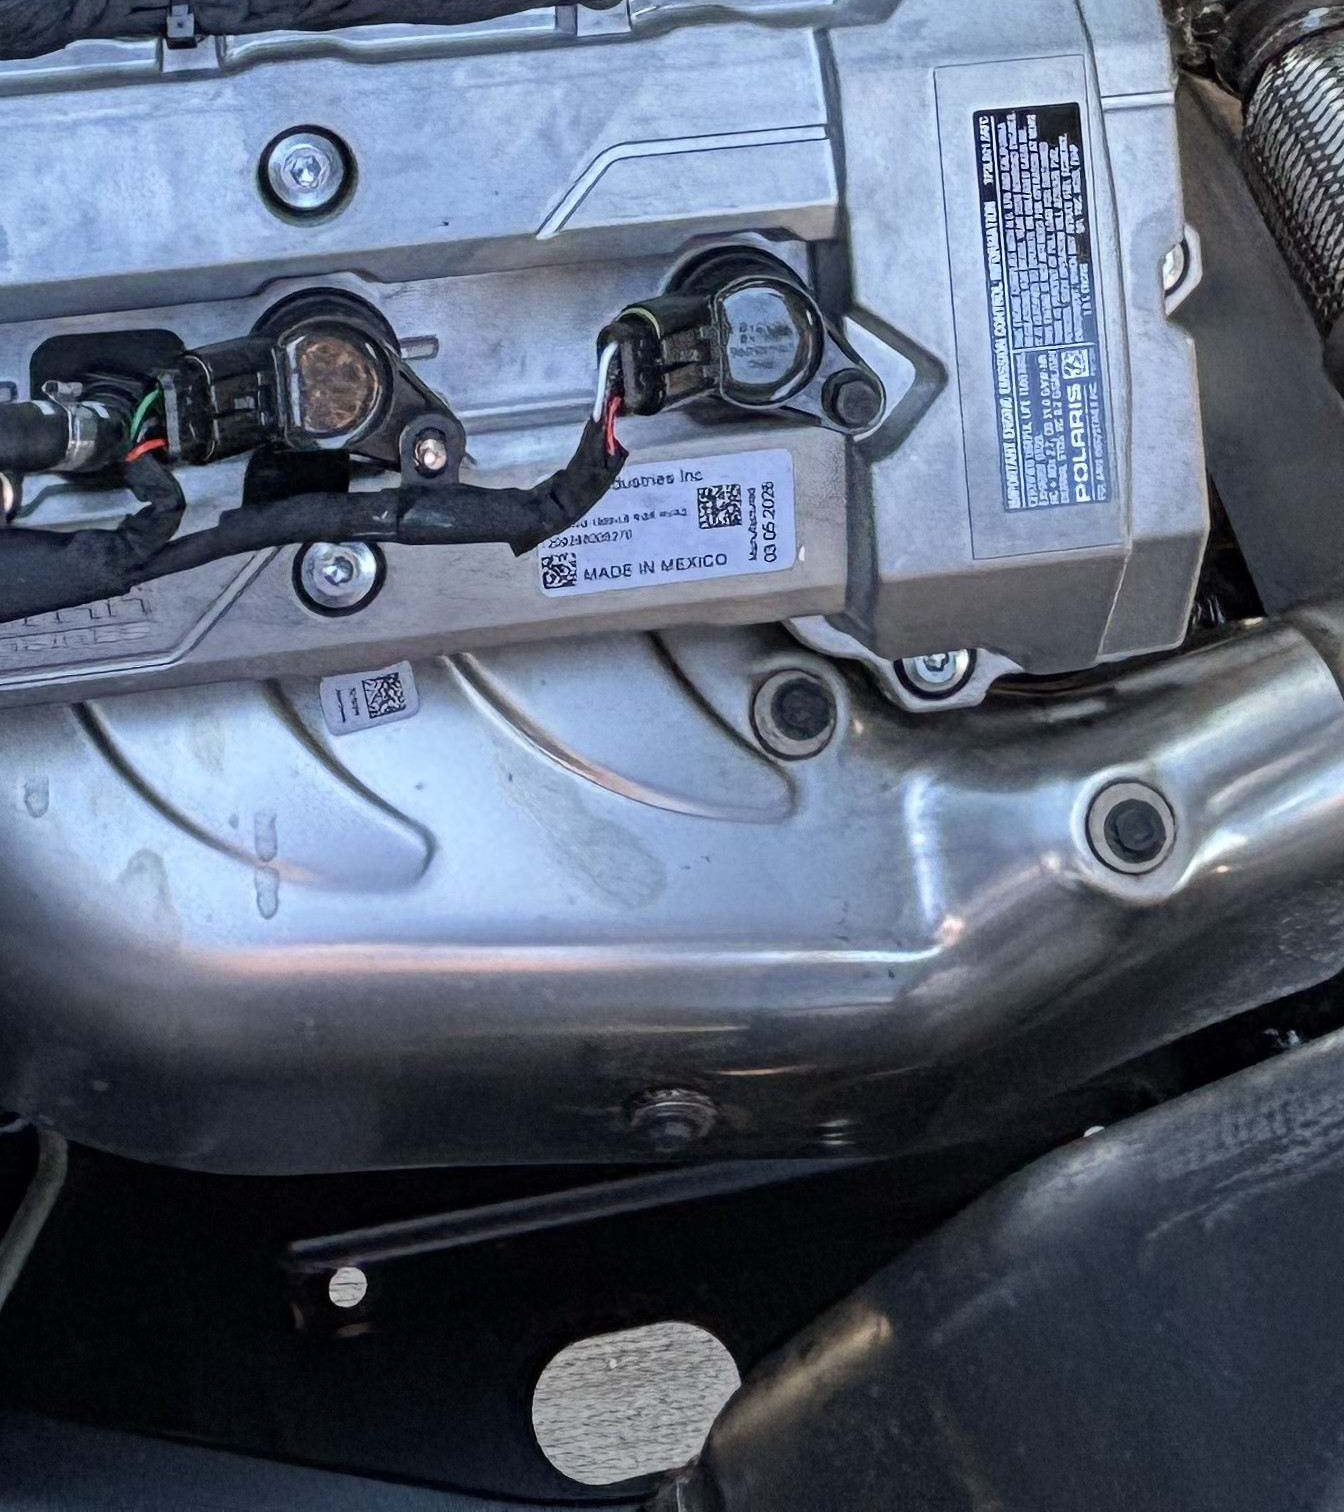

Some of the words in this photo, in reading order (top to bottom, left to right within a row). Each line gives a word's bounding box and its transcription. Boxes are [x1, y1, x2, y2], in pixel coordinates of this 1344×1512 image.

[1067, 381, 1091, 503] POLARIS
[583, 563, 632, 581] MADE
[639, 560, 655, 575] IN
[660, 553, 728, 572] MEXICO
